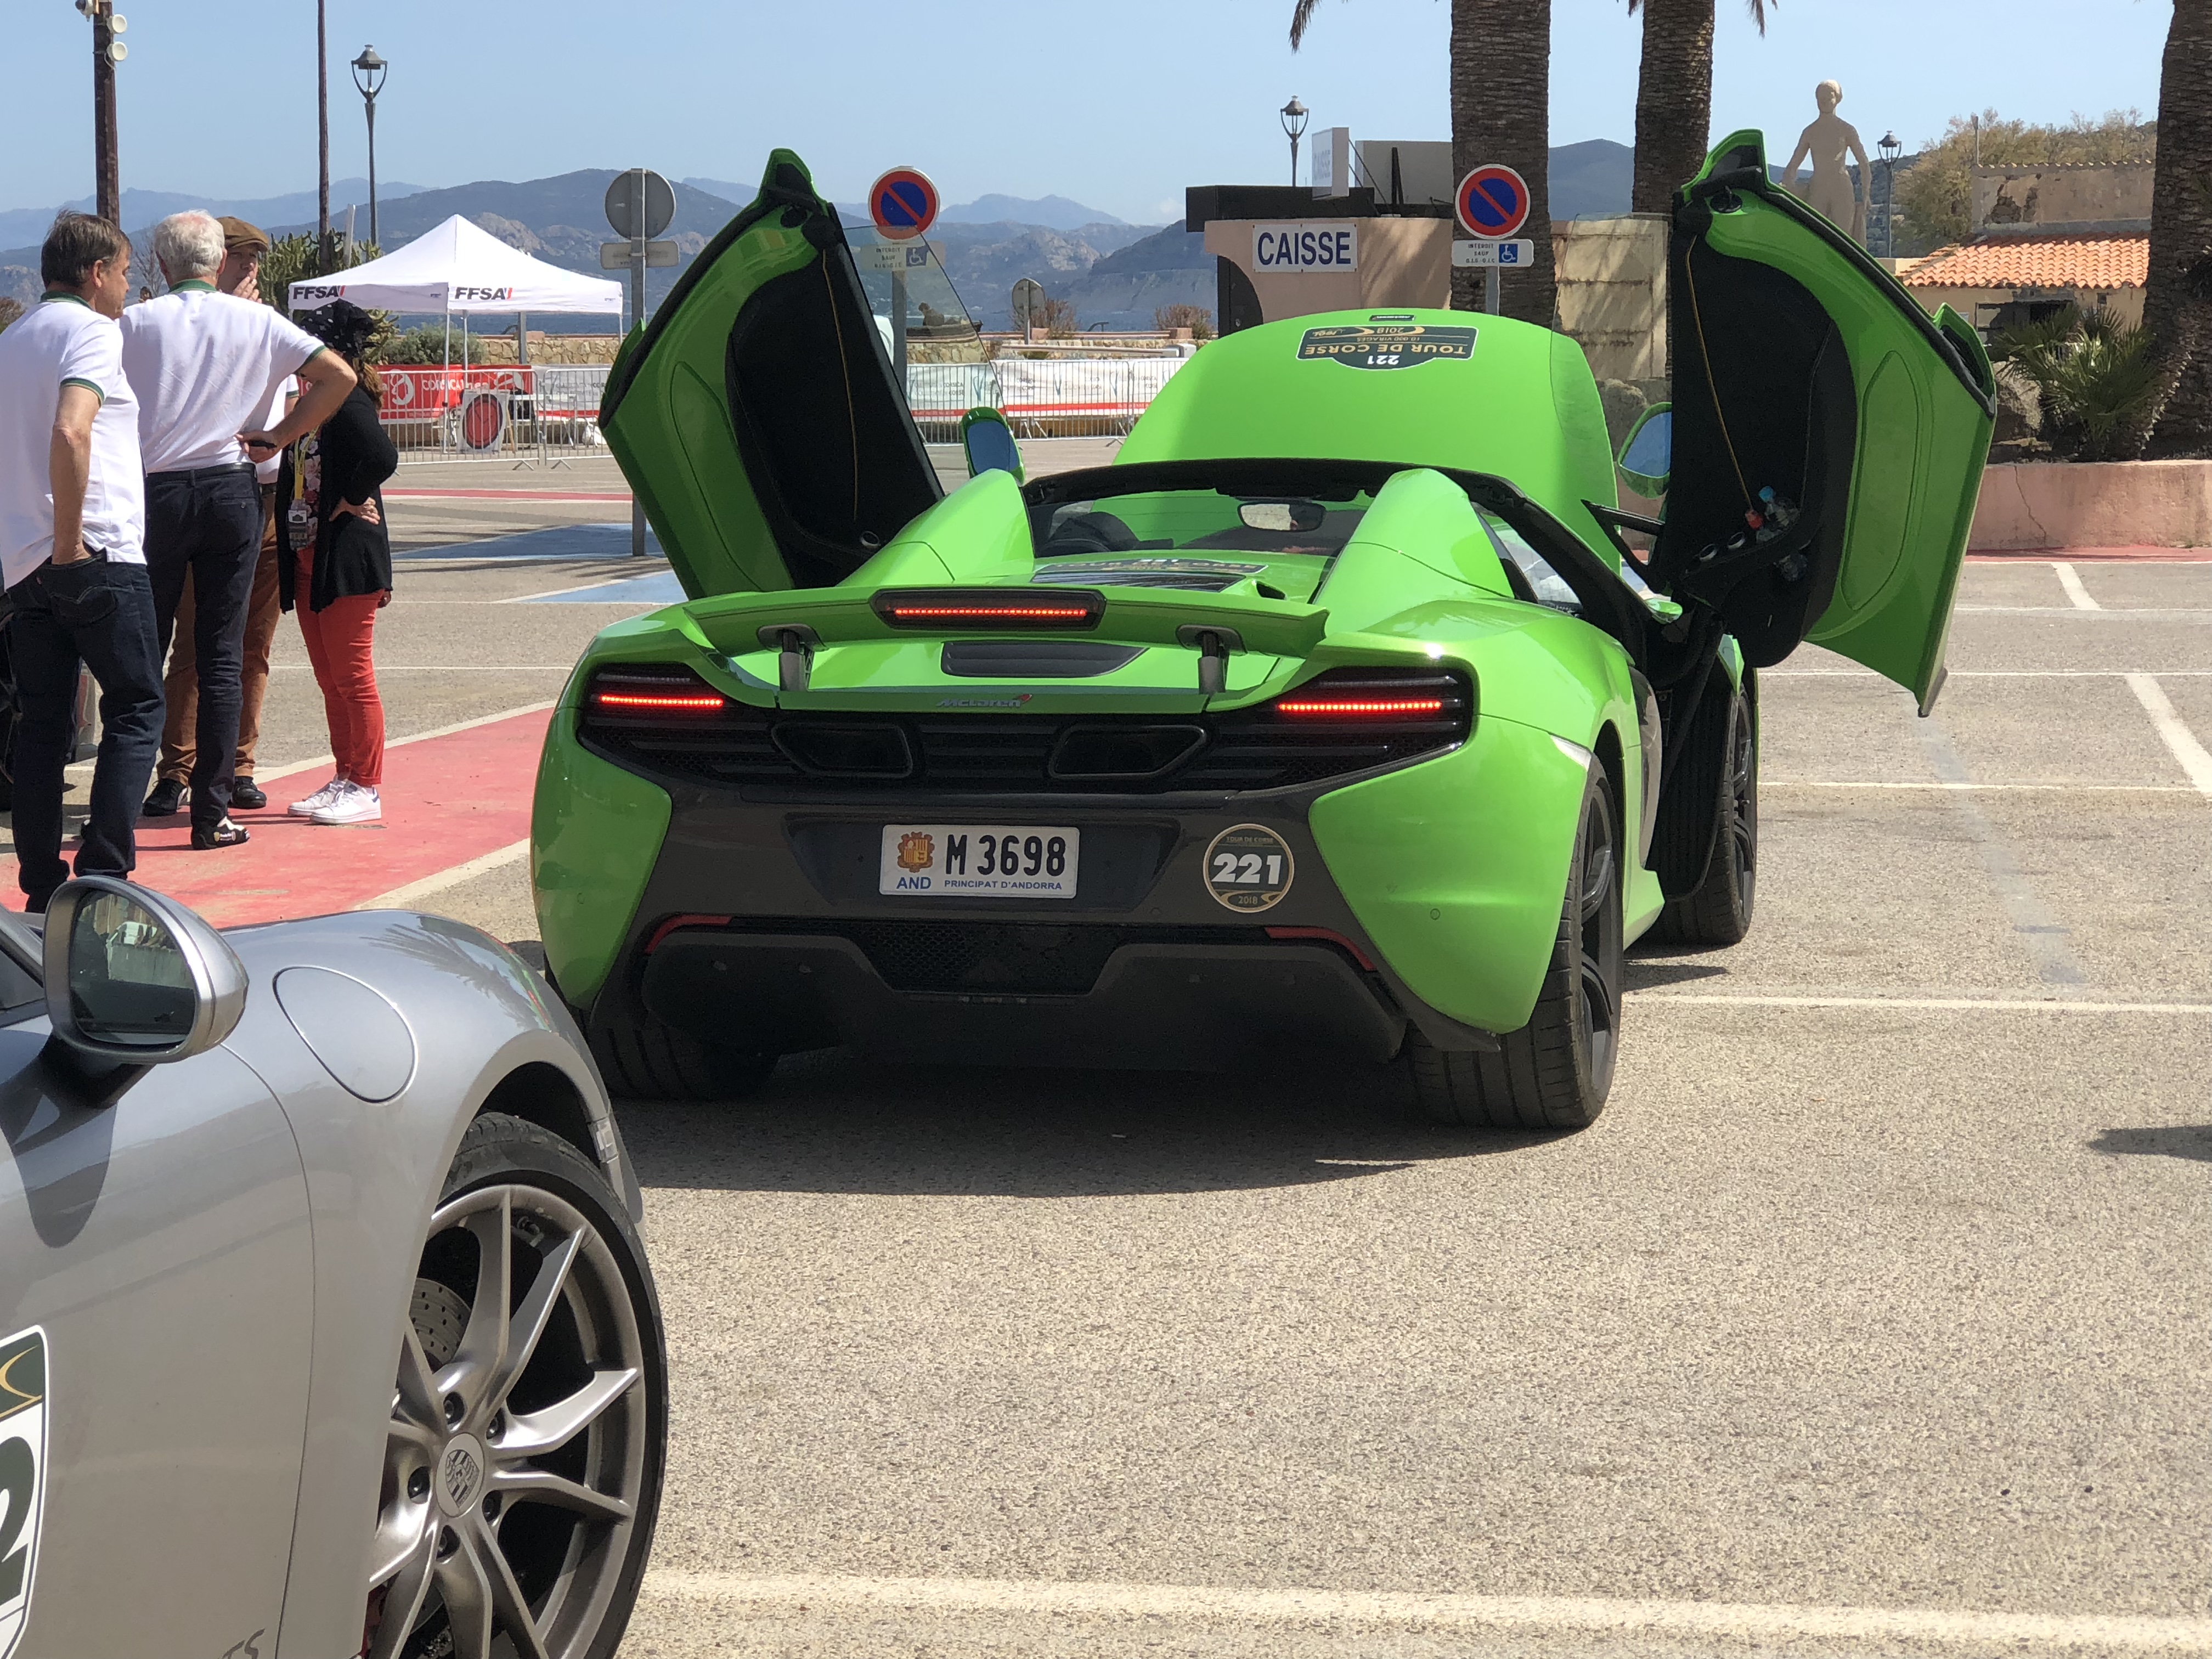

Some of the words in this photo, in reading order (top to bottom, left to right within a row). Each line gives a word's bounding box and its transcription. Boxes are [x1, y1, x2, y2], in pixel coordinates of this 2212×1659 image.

[1257, 231, 1351, 266] CAISSE
[293, 285, 338, 300] FFSA
[455, 287, 506, 300] FFSA
[1305, 345, 1370, 355] CORSE
[1377, 345, 1402, 353] DE
[1411, 345, 1466, 354] TOUR
[1367, 355, 1400, 365] 221
[945, 834, 967, 875] M
[977, 835, 1066, 877] 3698
[1211, 853, 1282, 885] 221
[896, 876, 932, 890] AND
[944, 880, 998, 889] PRINCIPAT
[1001, 881, 1062, 890] D'ANDORRA
[1238, 896, 1258, 905] 2018
